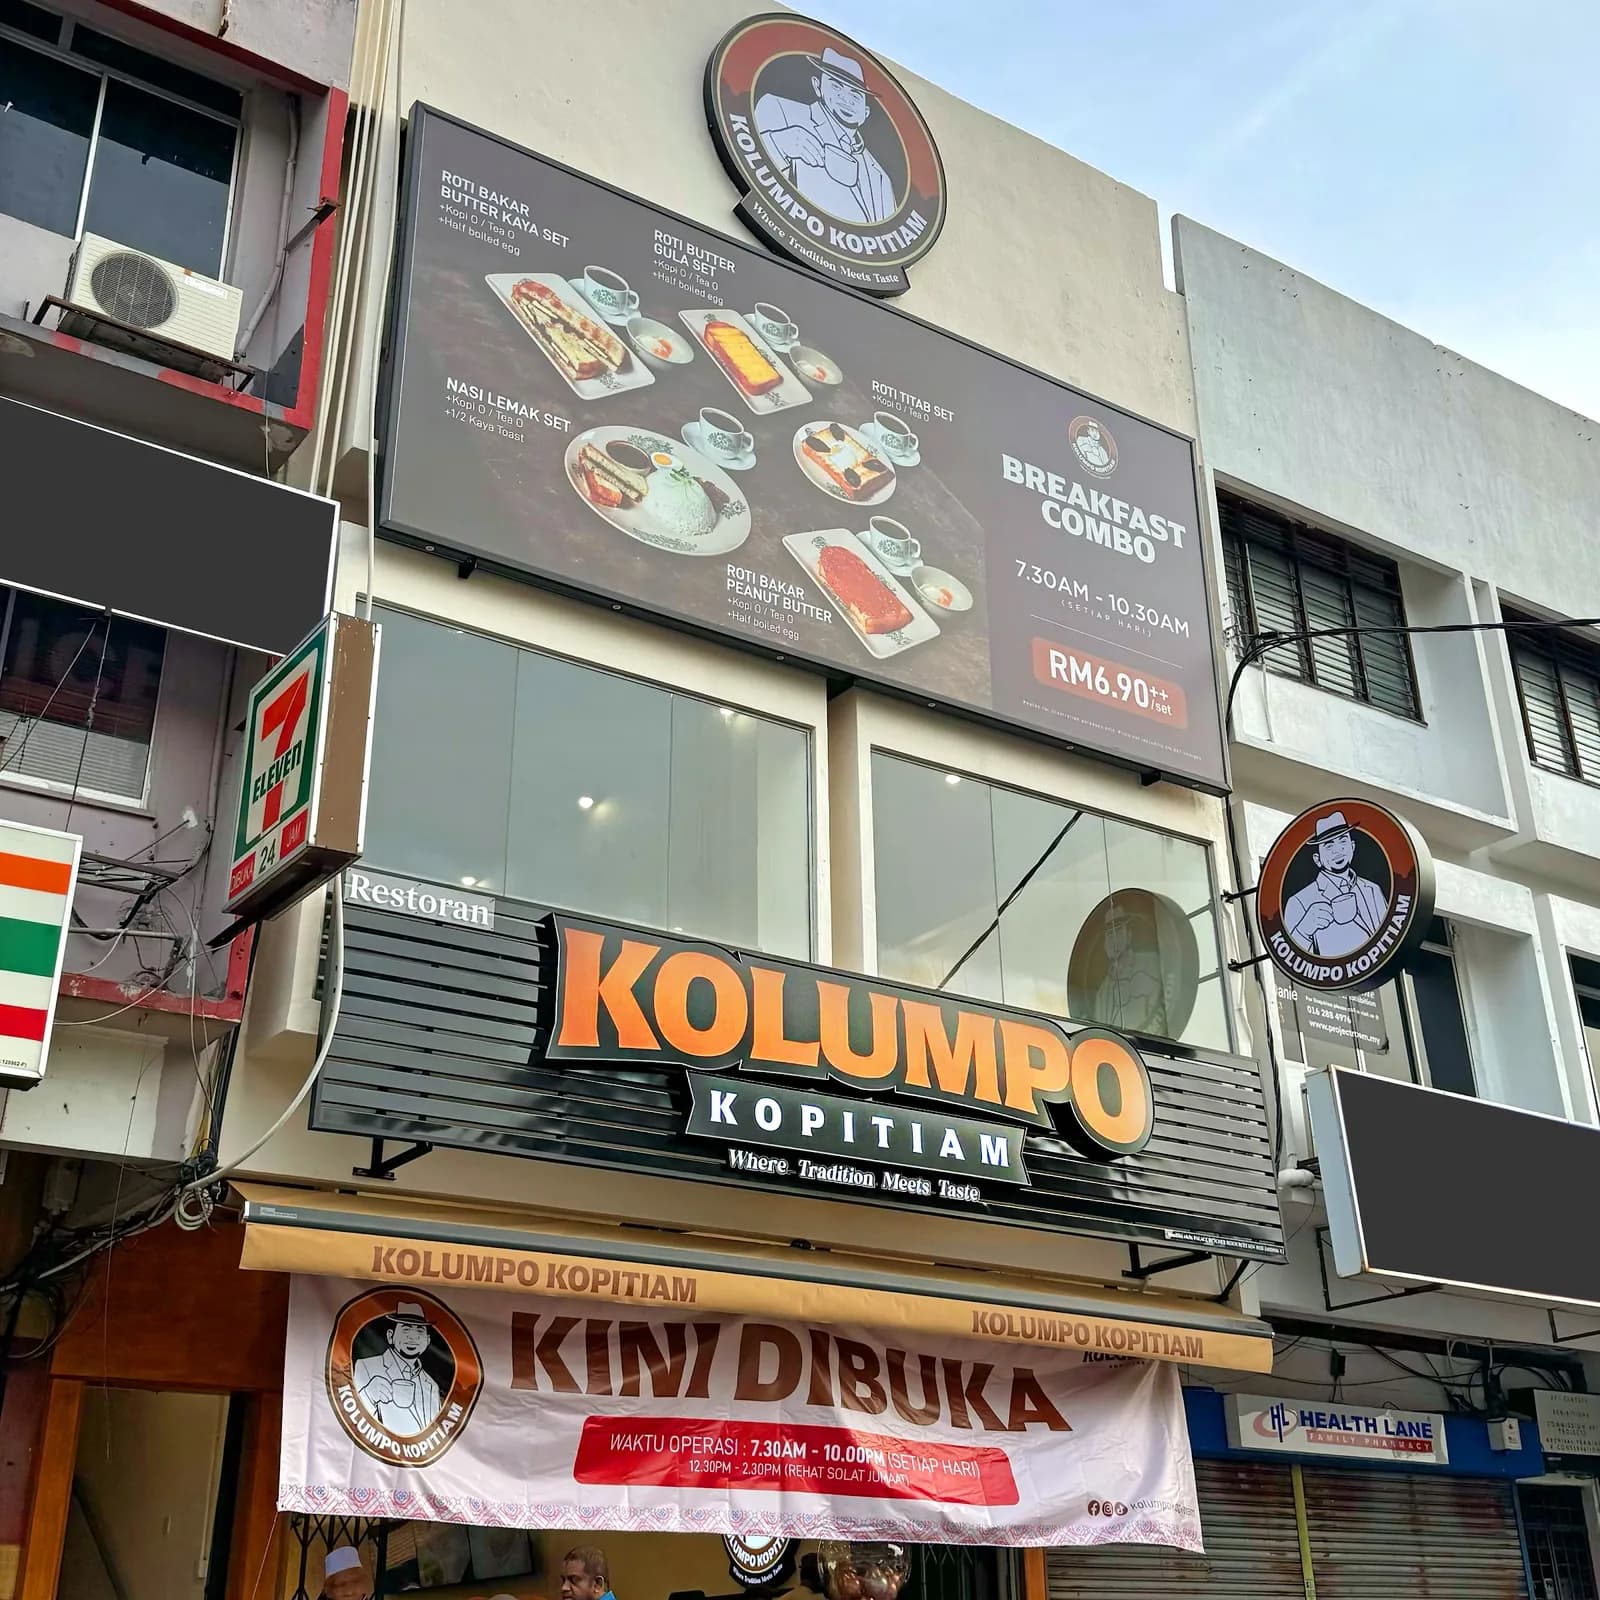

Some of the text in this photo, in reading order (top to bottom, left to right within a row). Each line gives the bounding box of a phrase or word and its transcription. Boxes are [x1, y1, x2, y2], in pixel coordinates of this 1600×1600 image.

[442, 169, 530, 217] ROTI BAKAR
[729, 113, 928, 255] KOLUMPO KOPITIAM
[441, 184, 570, 248] BUTTER KAYA SET
[488, 221, 506, 234] Tea
[469, 226, 500, 246] boiled
[502, 241, 520, 257] egg
[654, 229, 736, 273] ROTI BUTTER
[654, 242, 717, 277] GULA SET
[753, 201, 900, 283] Where Tradition Meets Taste
[679, 280, 706, 297] boiled
[708, 293, 725, 307] egg
[695, 274, 710, 287] Tea
[446, 376, 572, 433] NASI LEMAK SET
[496, 410, 513, 424] Tea
[872, 380, 955, 422] ROTI TITAB SET
[909, 407, 922, 420] Tea
[469, 415, 495, 433] Kaya
[497, 424, 525, 443] Toast
[1001, 453, 1187, 549] BREAKFAST
[1041, 500, 1156, 564] COMBO
[727, 563, 805, 600] ROTI BAKAR
[727, 578, 832, 623] PEANUT BUTTER
[1015, 559, 1090, 602] 7.30AM
[1108, 593, 1191, 639] 10.30AM
[753, 618, 781, 634] boiled
[783, 627, 800, 641] egg
[769, 608, 785, 621] Tea
[260, 669, 310, 833] 7
[259, 838, 277, 875] 24
[286, 820, 302, 848] JAM
[348, 874, 491, 927] Restoran
[1269, 894, 1412, 982] KOLUMPO KOPITIAM
[556, 927, 1138, 1145] KOLUMPO
[709, 1089, 1011, 1168] KOPITIAM
[727, 1148, 981, 1203] Where Tradition Meets Taste
[371, 1246, 698, 1303] KOLUMPO KOPITIAM
[971, 1310, 1205, 1360] KOLUMPO KOPITIAM
[510, 1311, 1074, 1433] KINI DIBUKA
[338, 1385, 464, 1459] KOLUMPO KOPITIAM
[1300, 1410, 1433, 1439] HEALTH LANE
[1309, 1432, 1432, 1451] FAMILY PHARMACY
[609, 1434, 664, 1453] WAKTU
[669, 1435, 738, 1456] OPERASI
[750, 1440, 807, 1460] 7.30AM
[823, 1444, 885, 1467] 10.00PM
[887, 1451, 939, 1474] (SETIAP
[942, 1459, 981, 1480] HARI)
[689, 1460, 731, 1473] 12.30PM
[742, 1462, 781, 1476] 2.30PM
[784, 1464, 824, 1479] (REHAT
[826, 1467, 863, 1482] SOLAT
